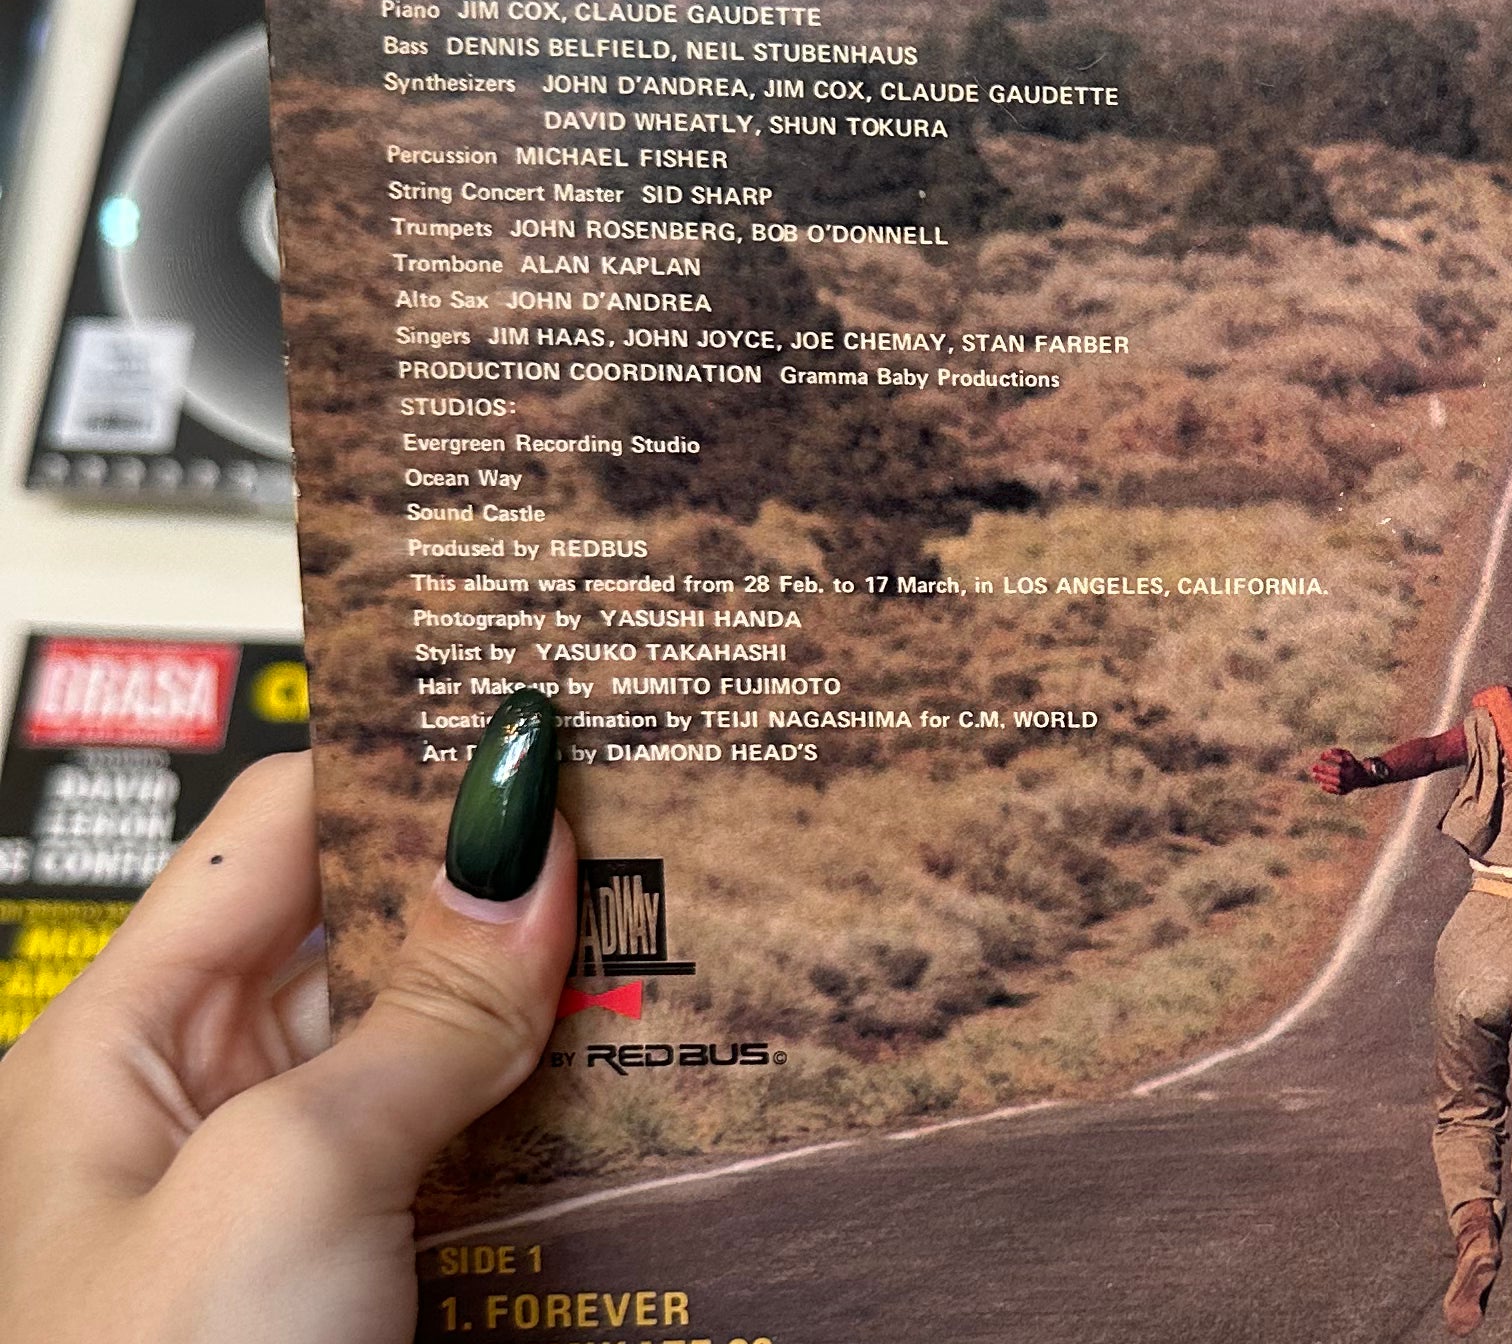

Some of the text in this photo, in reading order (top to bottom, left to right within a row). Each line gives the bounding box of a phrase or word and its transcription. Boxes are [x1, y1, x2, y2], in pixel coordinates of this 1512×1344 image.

[383, 73, 517, 94] Synthesizers
[542, 75, 607, 95] JOHN
[764, 80, 804, 98] JIM
[813, 81, 873, 103] COX,
[880, 82, 979, 102] CLAUDE
[988, 84, 1119, 106] GAUDETTE
[387, 182, 773, 206] String Concert Master SID SHARP
[390, 217, 949, 246] Trumpets JOHN ROSENBERG, BOB O'DONNELL
[398, 361, 1060, 390] PRODUCTION COORDINATION Gramma Baby Productions
[400, 398, 517, 417] STUDIOS:
[403, 434, 701, 456] Evergreen Recording Studio
[406, 504, 546, 523] Sound Castle
[408, 539, 648, 560] Prodused by REDBUS
[410, 574, 1329, 599] This album was recorded from 28 Feb. to 17 March, in LOS ANGELES, CALIFORNIA.
[412, 609, 802, 631] Photography by YASUSHI HANDA
[418, 677, 462, 696] Hair
[567, 678, 594, 698] by
[612, 678, 712, 696] MUMITO
[720, 678, 841, 696] FUJIMOTO
[666, 711, 692, 732] by
[701, 711, 759, 728] TEIJI
[768, 710, 912, 729] NAGASHIMA
[920, 711, 950, 729] for
[1013, 711, 1099, 729] WORLD
[423, 744, 457, 762] Art
[571, 744, 597, 765] by
[607, 744, 723, 763] DIAMOND
[731, 743, 819, 762] HEAD'S
[438, 1245, 543, 1276] SIDE 1
[440, 1291, 690, 1330] 1. FOREVER
